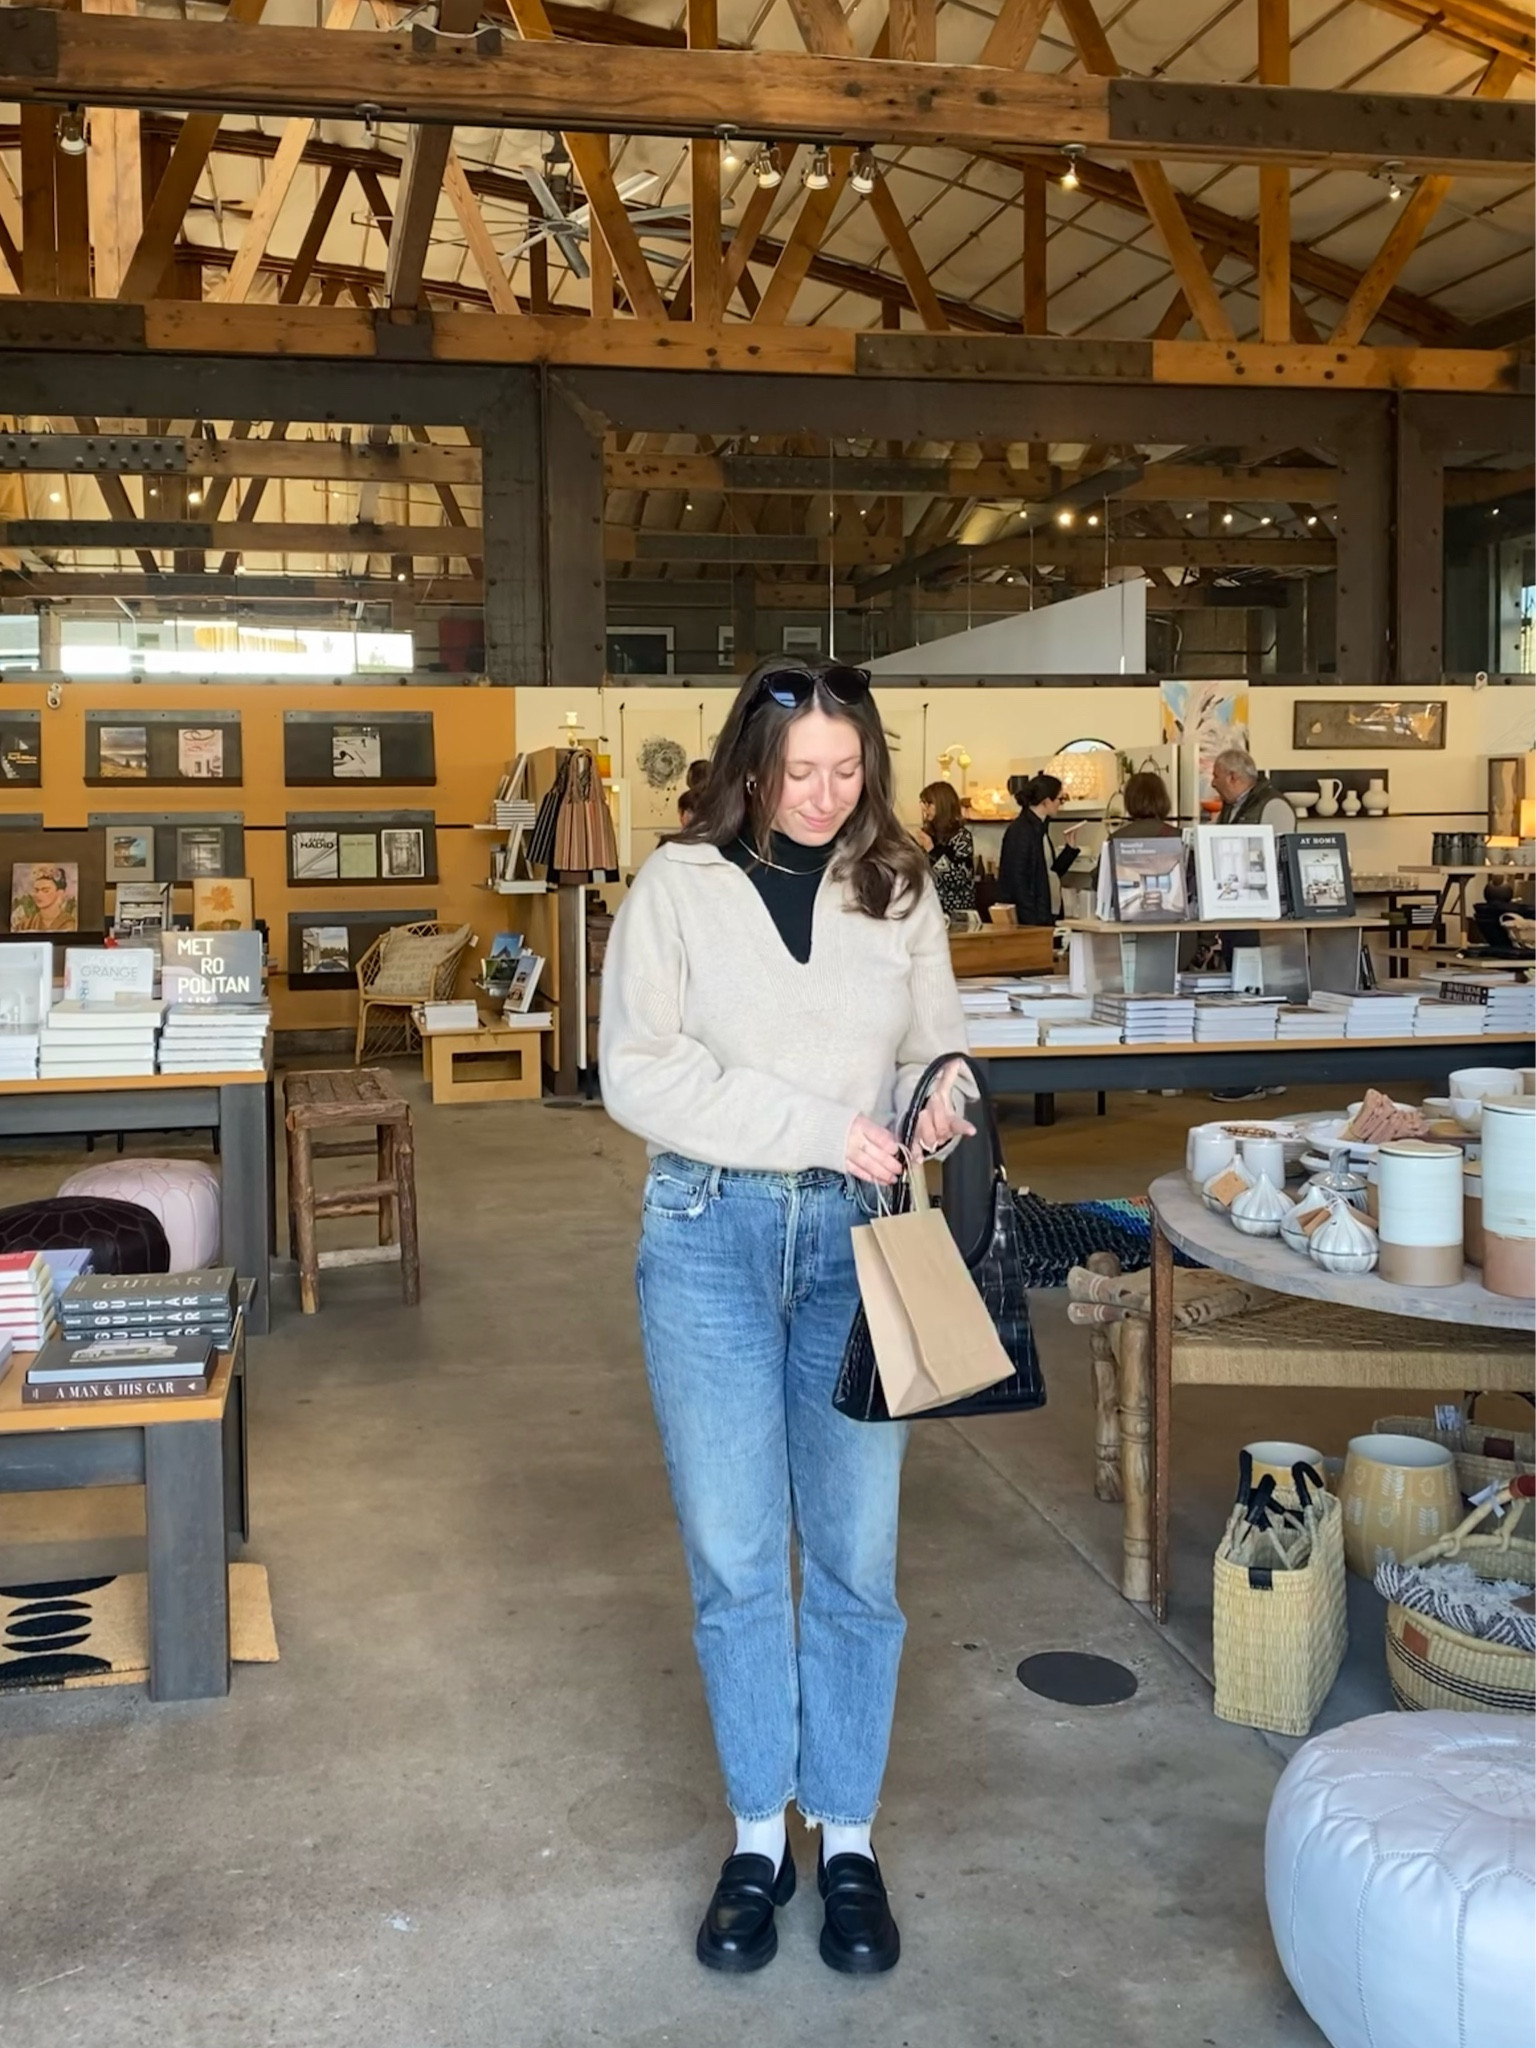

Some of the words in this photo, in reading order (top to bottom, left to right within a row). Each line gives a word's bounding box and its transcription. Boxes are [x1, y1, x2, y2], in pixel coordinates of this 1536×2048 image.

[300, 841, 334, 849] HADID
[177, 938, 214, 955] MET
[201, 957, 224, 975] RO
[178, 976, 250, 994] POLITAN
[92, 1296, 199, 1310] GUITAR
[94, 1311, 200, 1325] GUITAR
[94, 1327, 200, 1340] GUITAR
[56, 1388, 65, 1399] A
[69, 1385, 98, 1398] MAN
[103, 1384, 114, 1397] &
[118, 1383, 142, 1396] HIS
[146, 1382, 175, 1395] CAR
